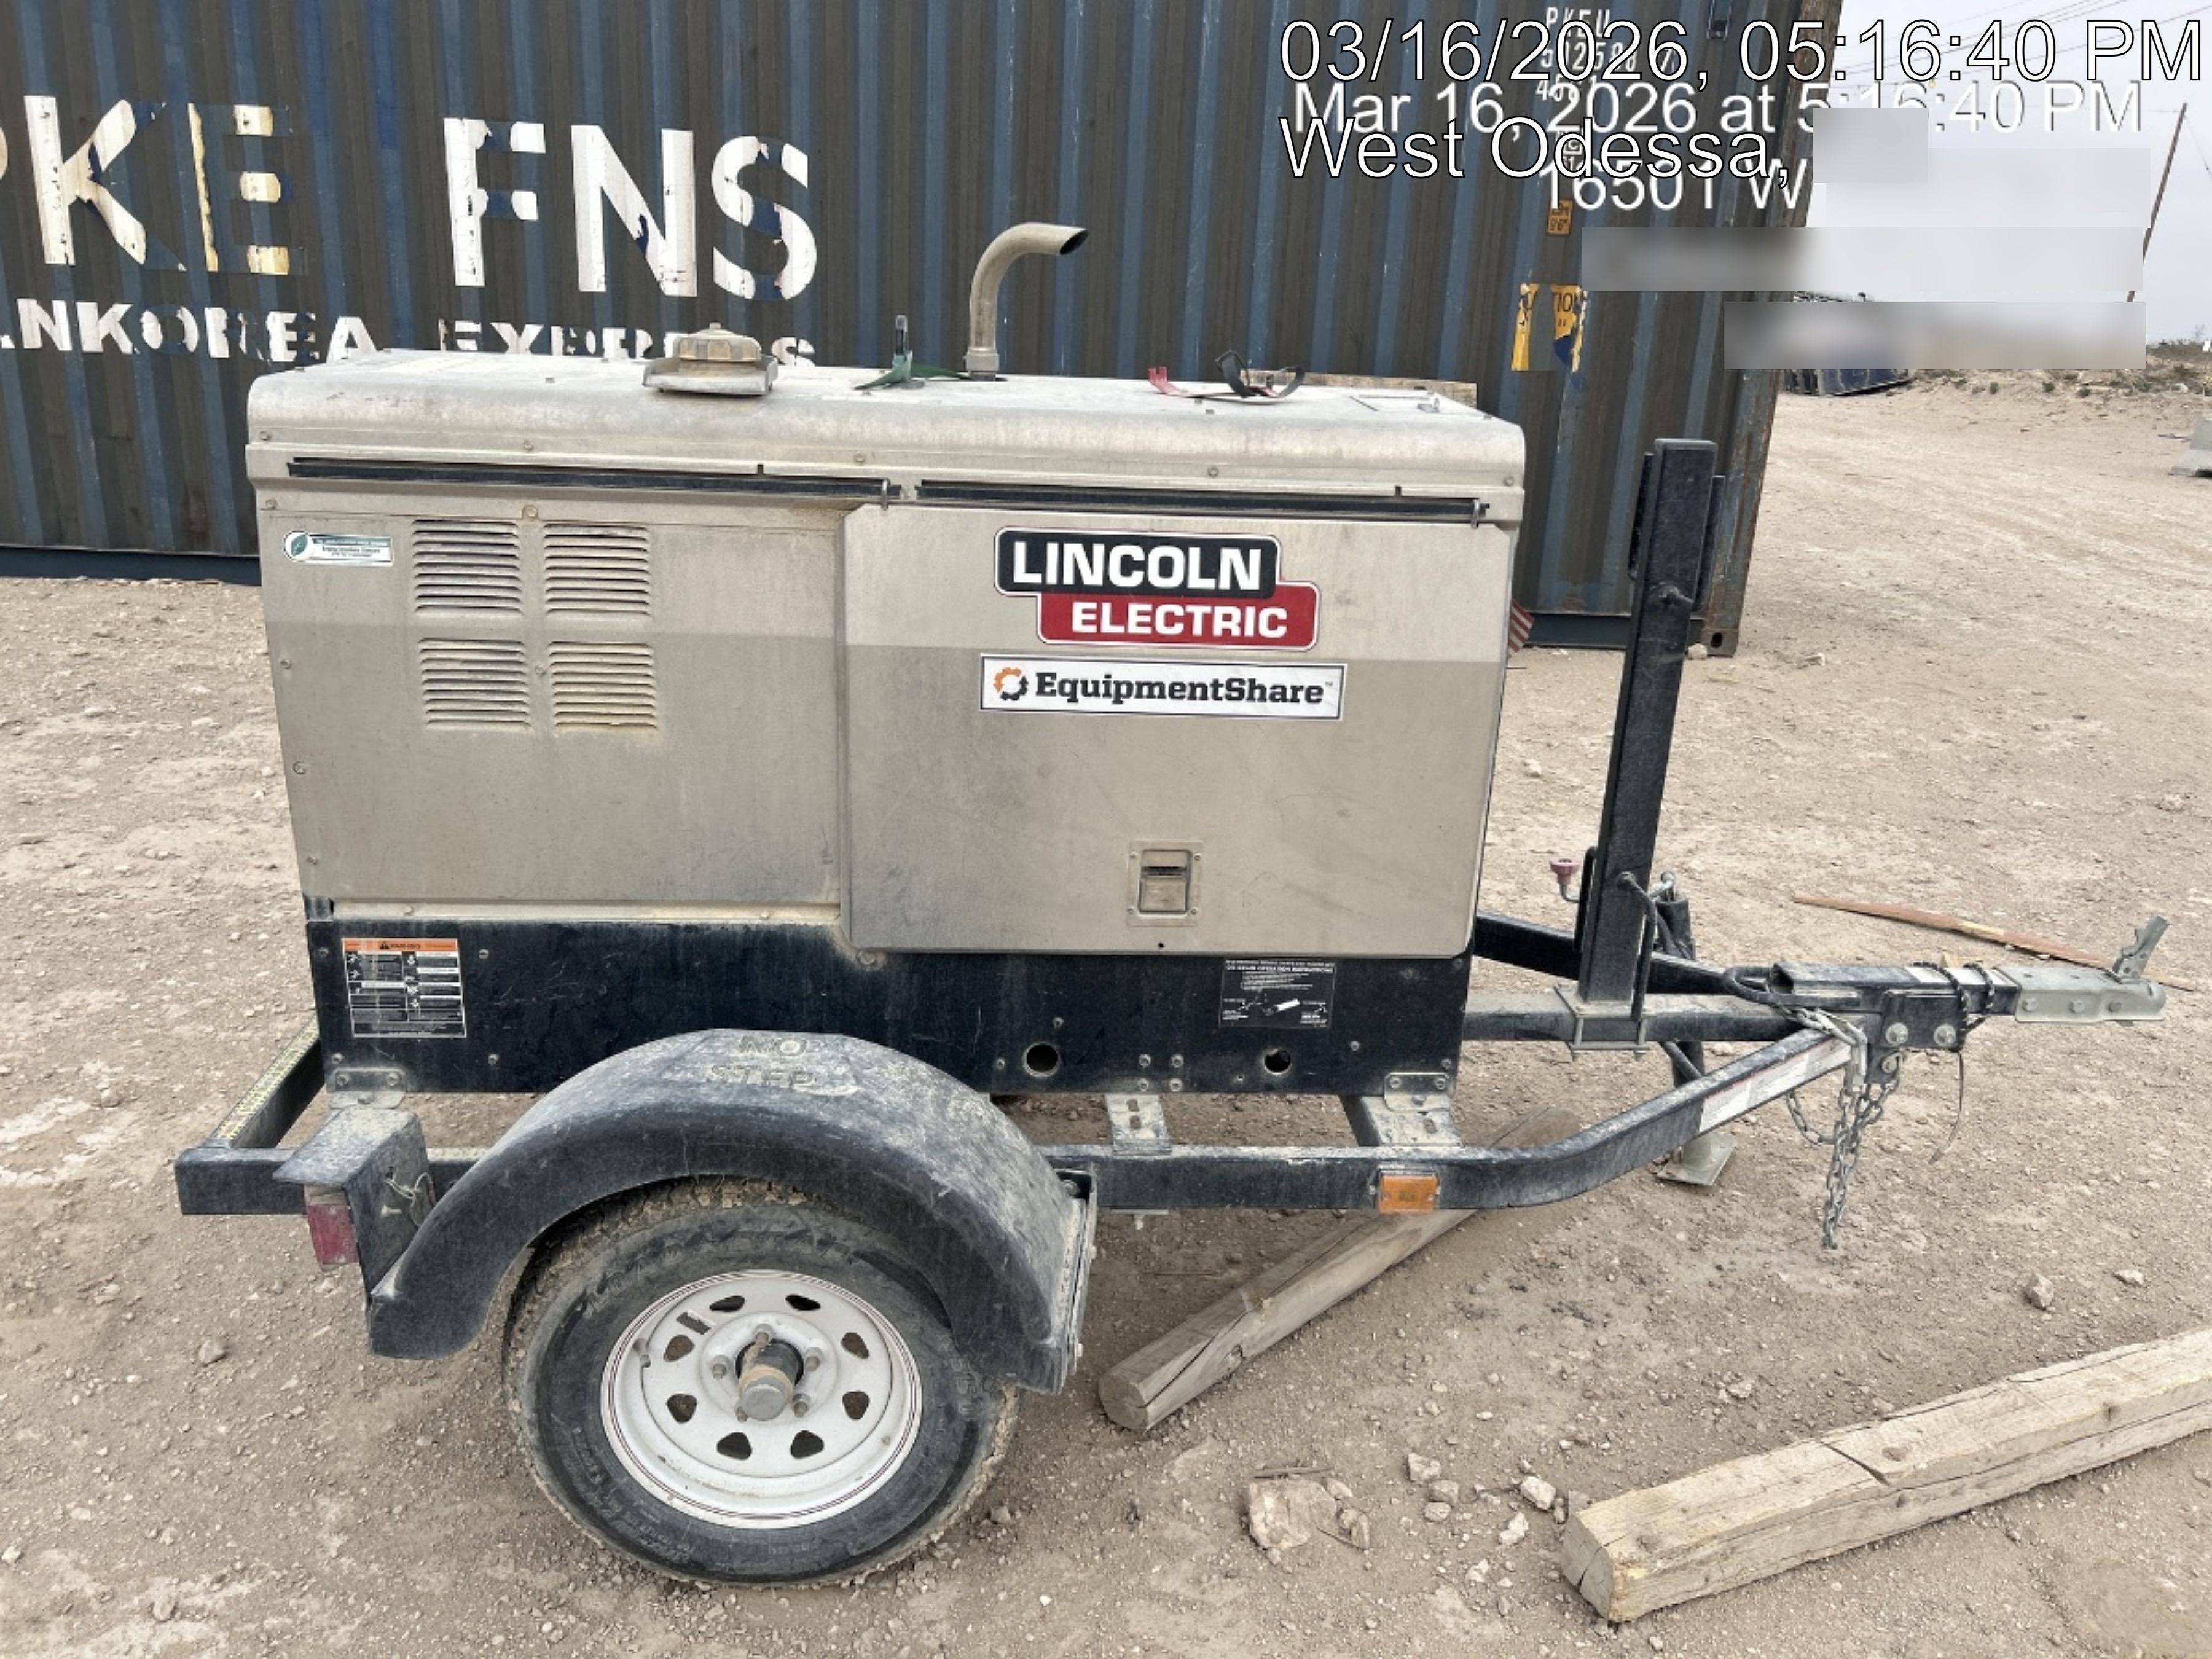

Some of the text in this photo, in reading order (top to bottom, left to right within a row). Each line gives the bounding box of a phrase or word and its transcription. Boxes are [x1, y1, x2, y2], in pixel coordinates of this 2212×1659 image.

[0, 95, 294, 276] KE
[443, 117, 818, 301] FNS
[438, 318, 816, 368] EXPRS
[1013, 541, 1261, 591] LINCOLN
[1072, 602, 1288, 638] ELECTRIC
[1035, 672, 1324, 704] EquipmentShare
